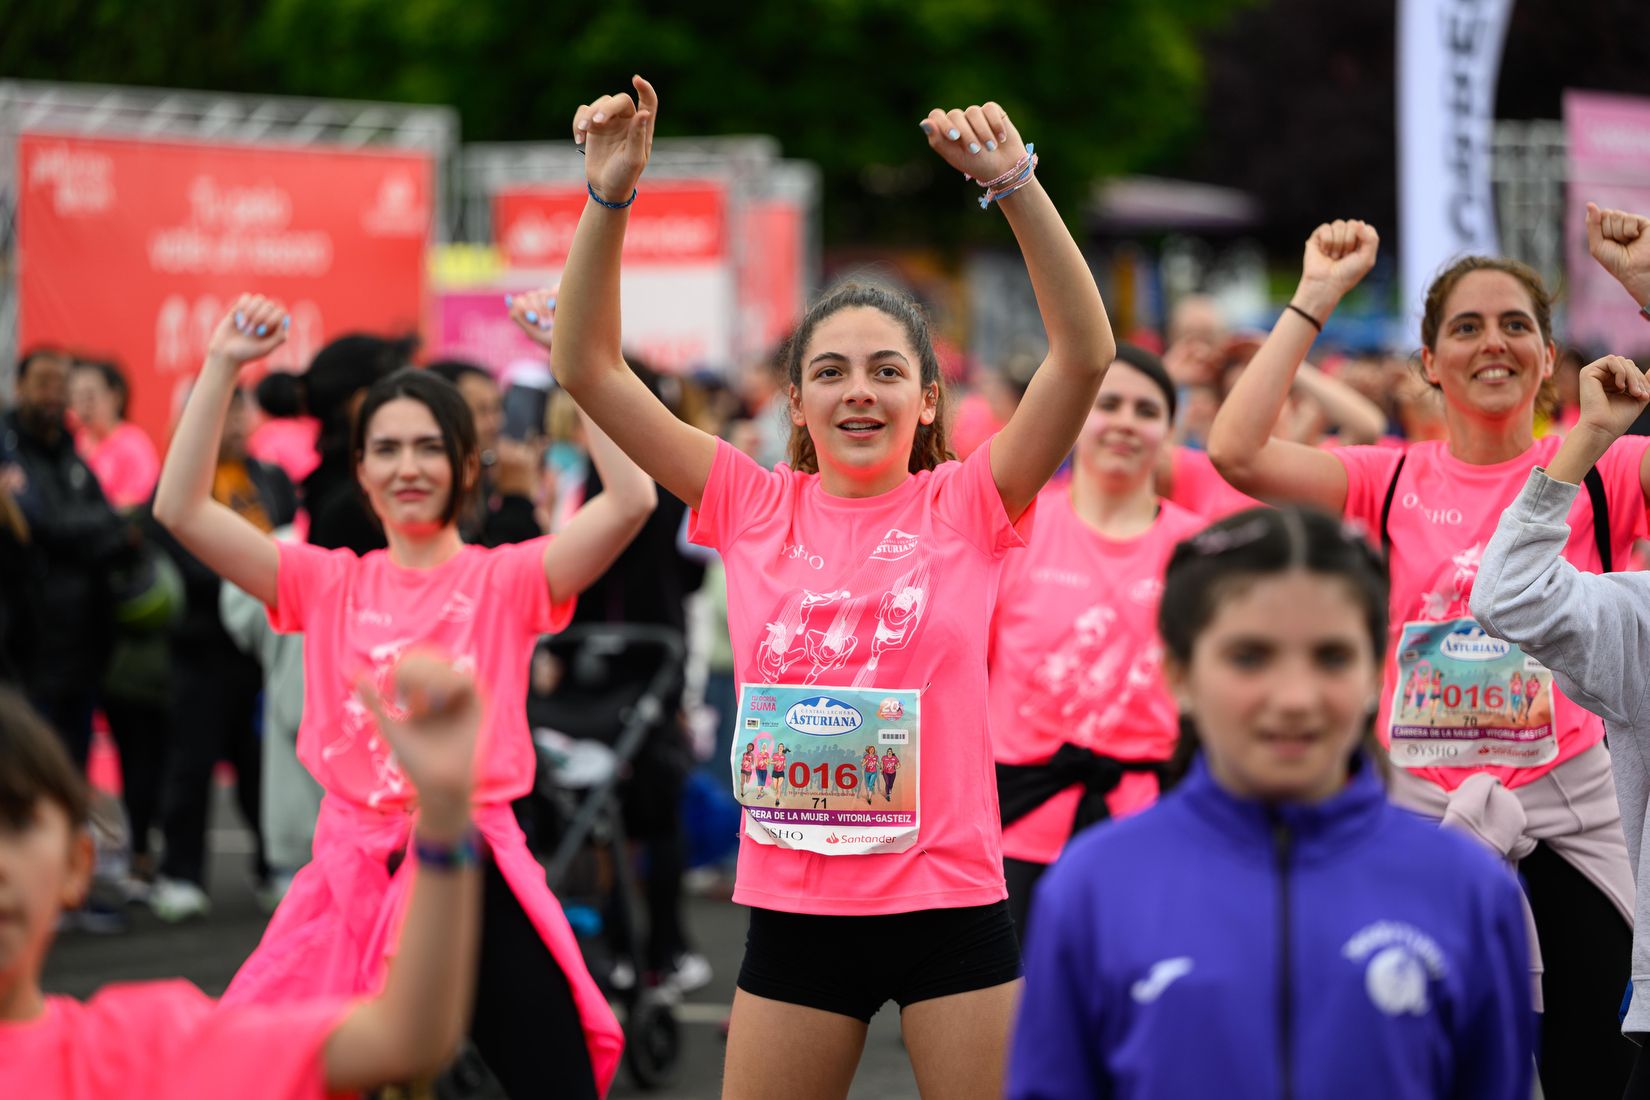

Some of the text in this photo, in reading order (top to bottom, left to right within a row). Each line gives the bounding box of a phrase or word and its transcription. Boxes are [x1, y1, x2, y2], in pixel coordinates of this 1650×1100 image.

[1446, 640, 1505, 653] ASTURIANA
[1443, 684, 1504, 708] 016
[750, 701, 777, 711] SUMA
[881, 700, 900, 713] 20
[788, 709, 857, 727] ASTURIANA
[1463, 715, 1478, 727] 70
[1441, 729, 1452, 737] LA
[1407, 744, 1458, 758] OYSHO
[788, 761, 859, 790] 016
[812, 797, 827, 809] 71
[774, 811, 785, 820] DE
[787, 812, 799, 820] LA
[800, 812, 830, 822] MUJER
[837, 813, 912, 823] VITORIA-GASTEIZ
[841, 834, 897, 844] Santander
